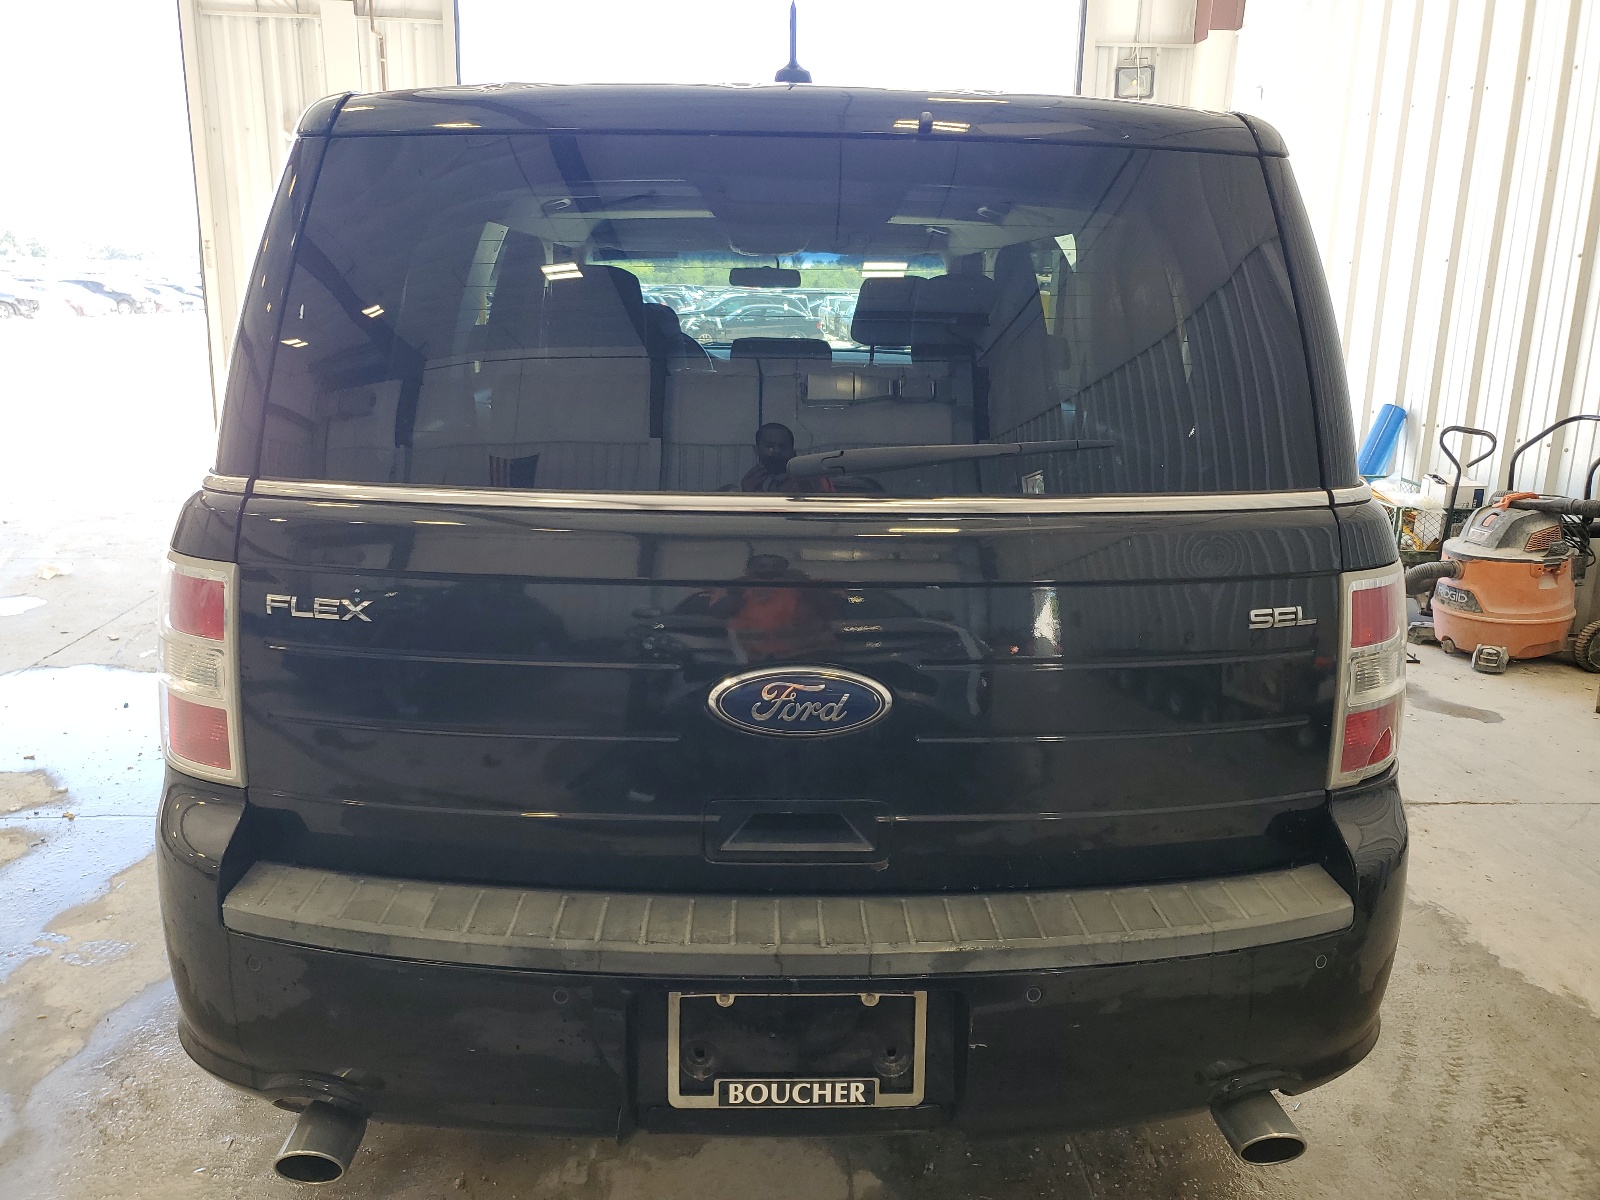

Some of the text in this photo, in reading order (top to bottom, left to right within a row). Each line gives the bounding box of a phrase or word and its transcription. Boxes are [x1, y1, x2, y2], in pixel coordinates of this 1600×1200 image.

[266, 593, 373, 622] FLEX
[1249, 606, 1317, 629] SEL
[751, 681, 850, 721] Ford
[728, 1083, 866, 1104] BOUCHER
